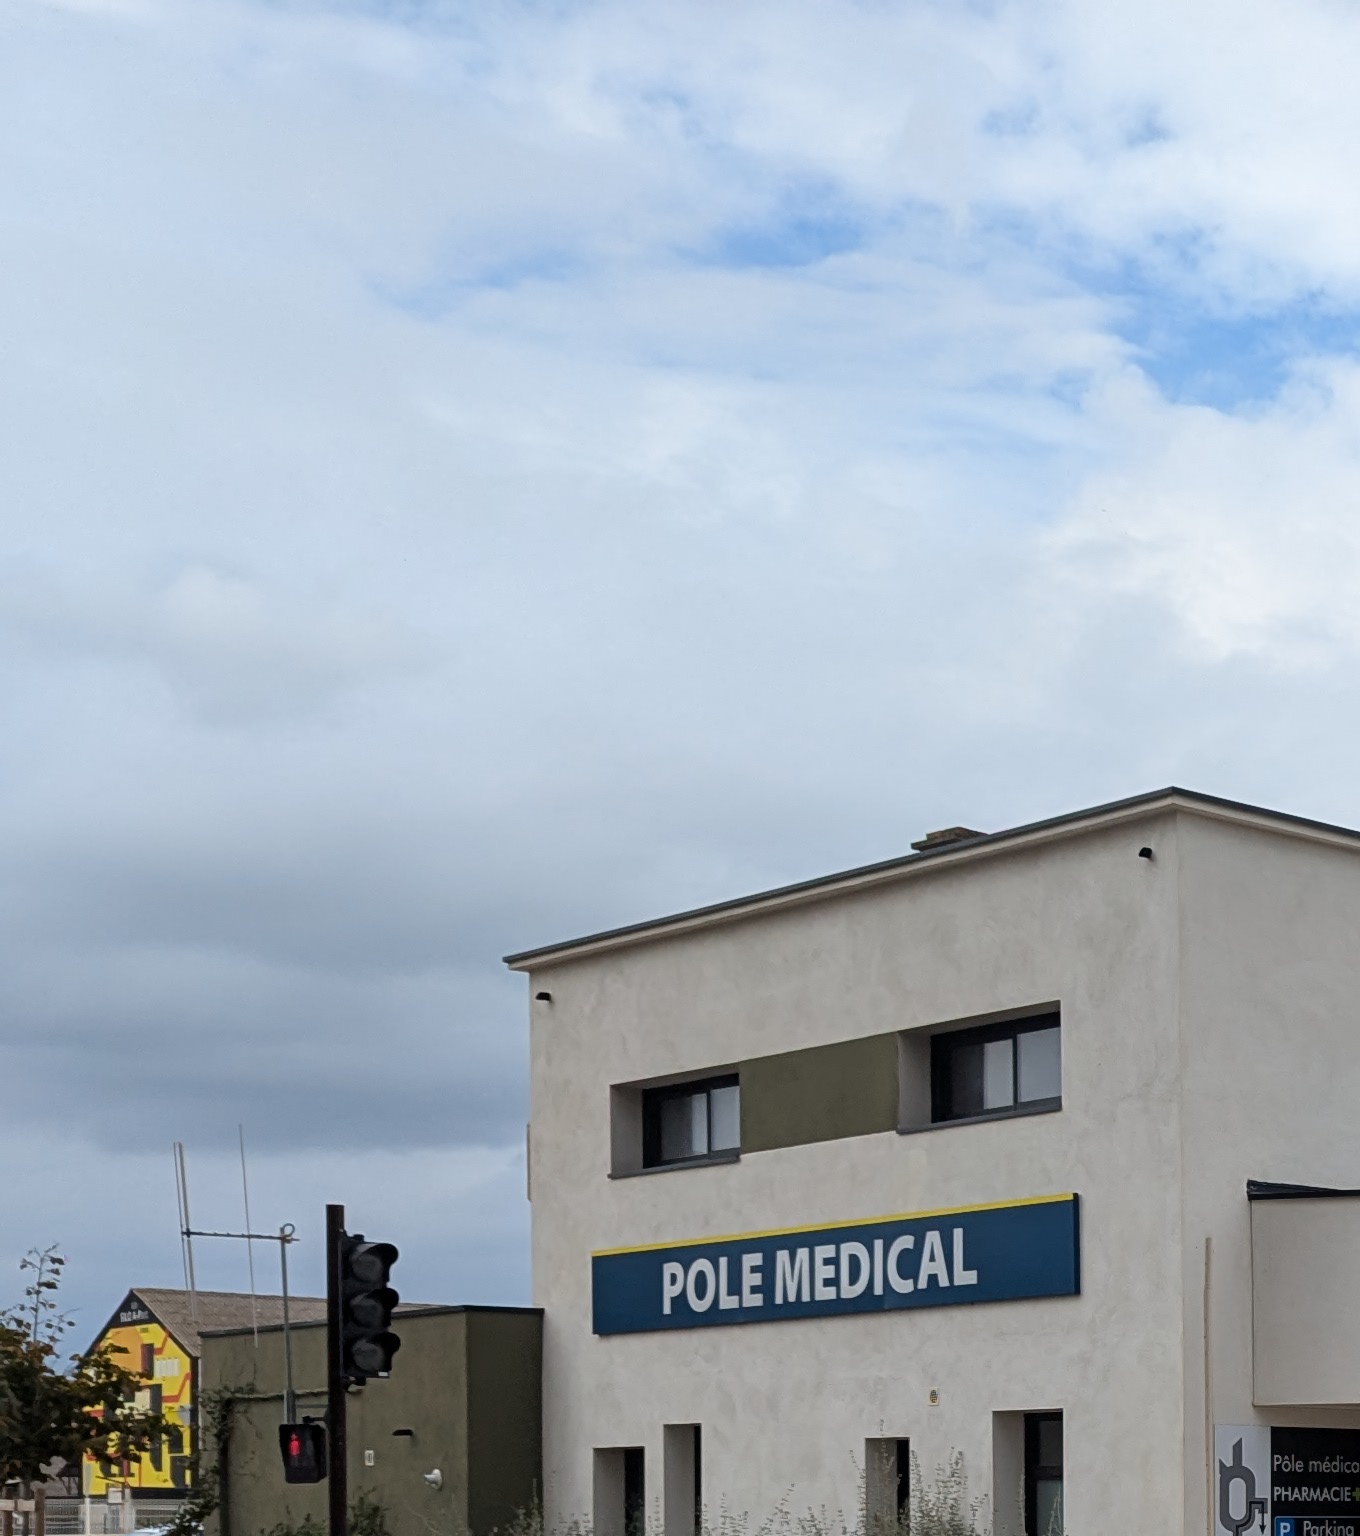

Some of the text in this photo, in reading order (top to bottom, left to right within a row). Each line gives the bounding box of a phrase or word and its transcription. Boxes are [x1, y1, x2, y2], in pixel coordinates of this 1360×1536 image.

[663, 1227, 978, 1315] POLE MEDICAL
[1273, 1453, 1304, 1472] Pôle
[1273, 1486, 1352, 1501] PHARMACIE
